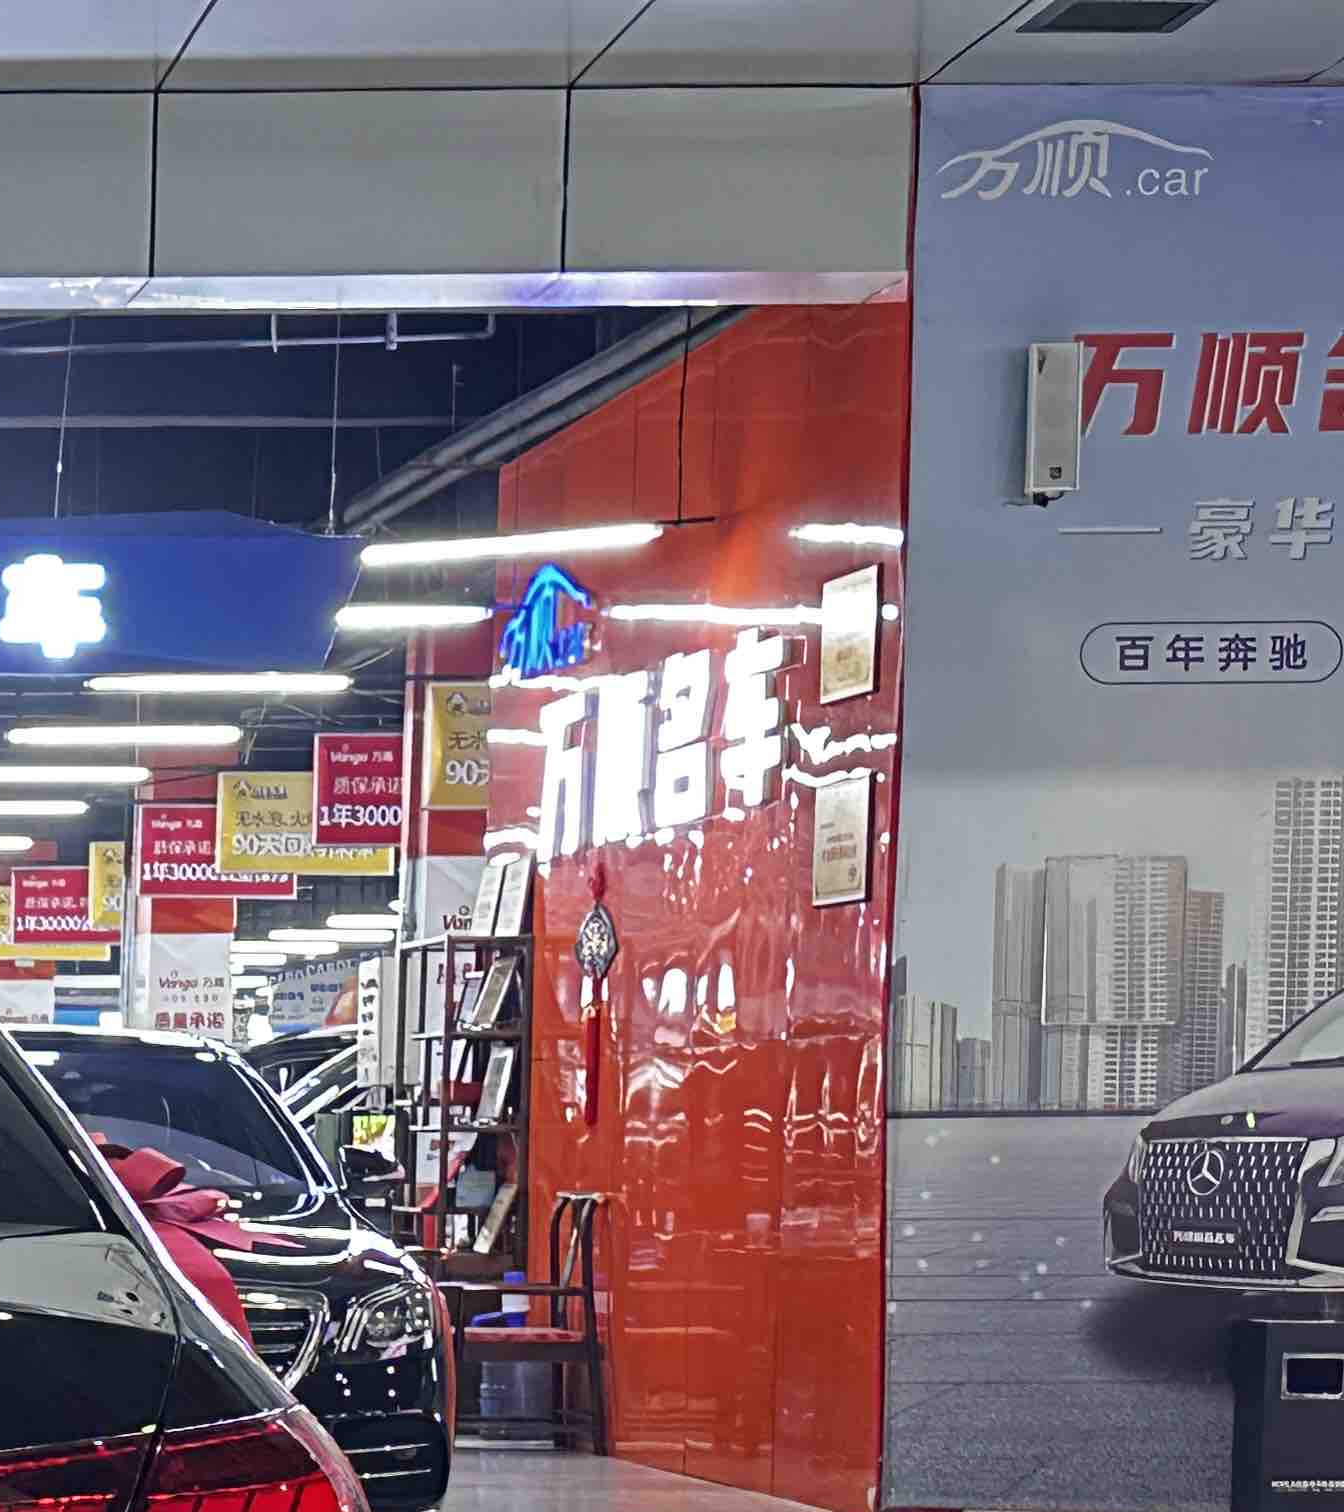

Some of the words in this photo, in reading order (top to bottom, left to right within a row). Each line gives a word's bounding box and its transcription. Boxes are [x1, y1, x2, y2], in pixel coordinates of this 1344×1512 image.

[940, 128, 1113, 199] 万顺
[1075, 331, 1344, 437] 万顺
[1115, 634, 1309, 672] 百年奔驰
